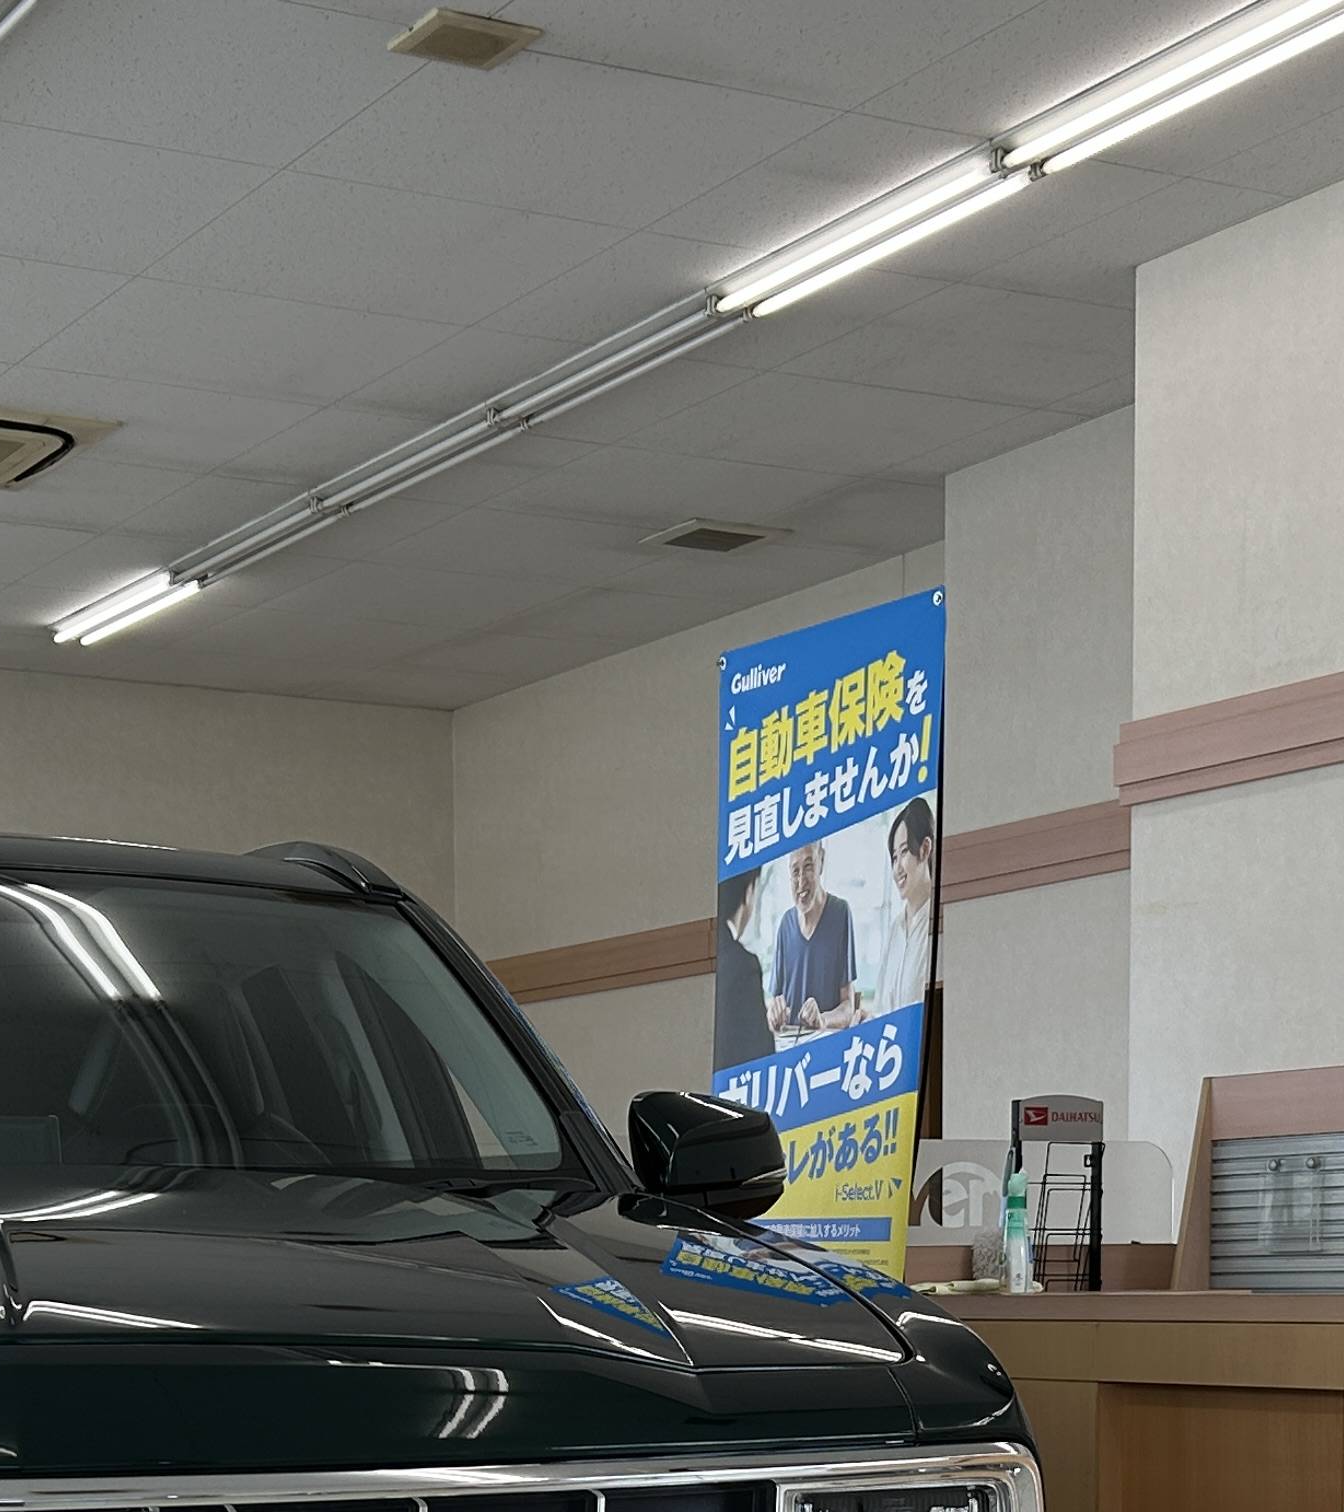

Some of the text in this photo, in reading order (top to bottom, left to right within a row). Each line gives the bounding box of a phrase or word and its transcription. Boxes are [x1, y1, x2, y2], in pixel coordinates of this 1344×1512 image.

[731, 663, 787, 695] Gulliver
[728, 650, 928, 803] 自動車保険を
[724, 714, 932, 866] 見直しませんか!
[784, 1107, 900, 1185] レがある!!
[1051, 1111, 1101, 1123] DAIHATSU
